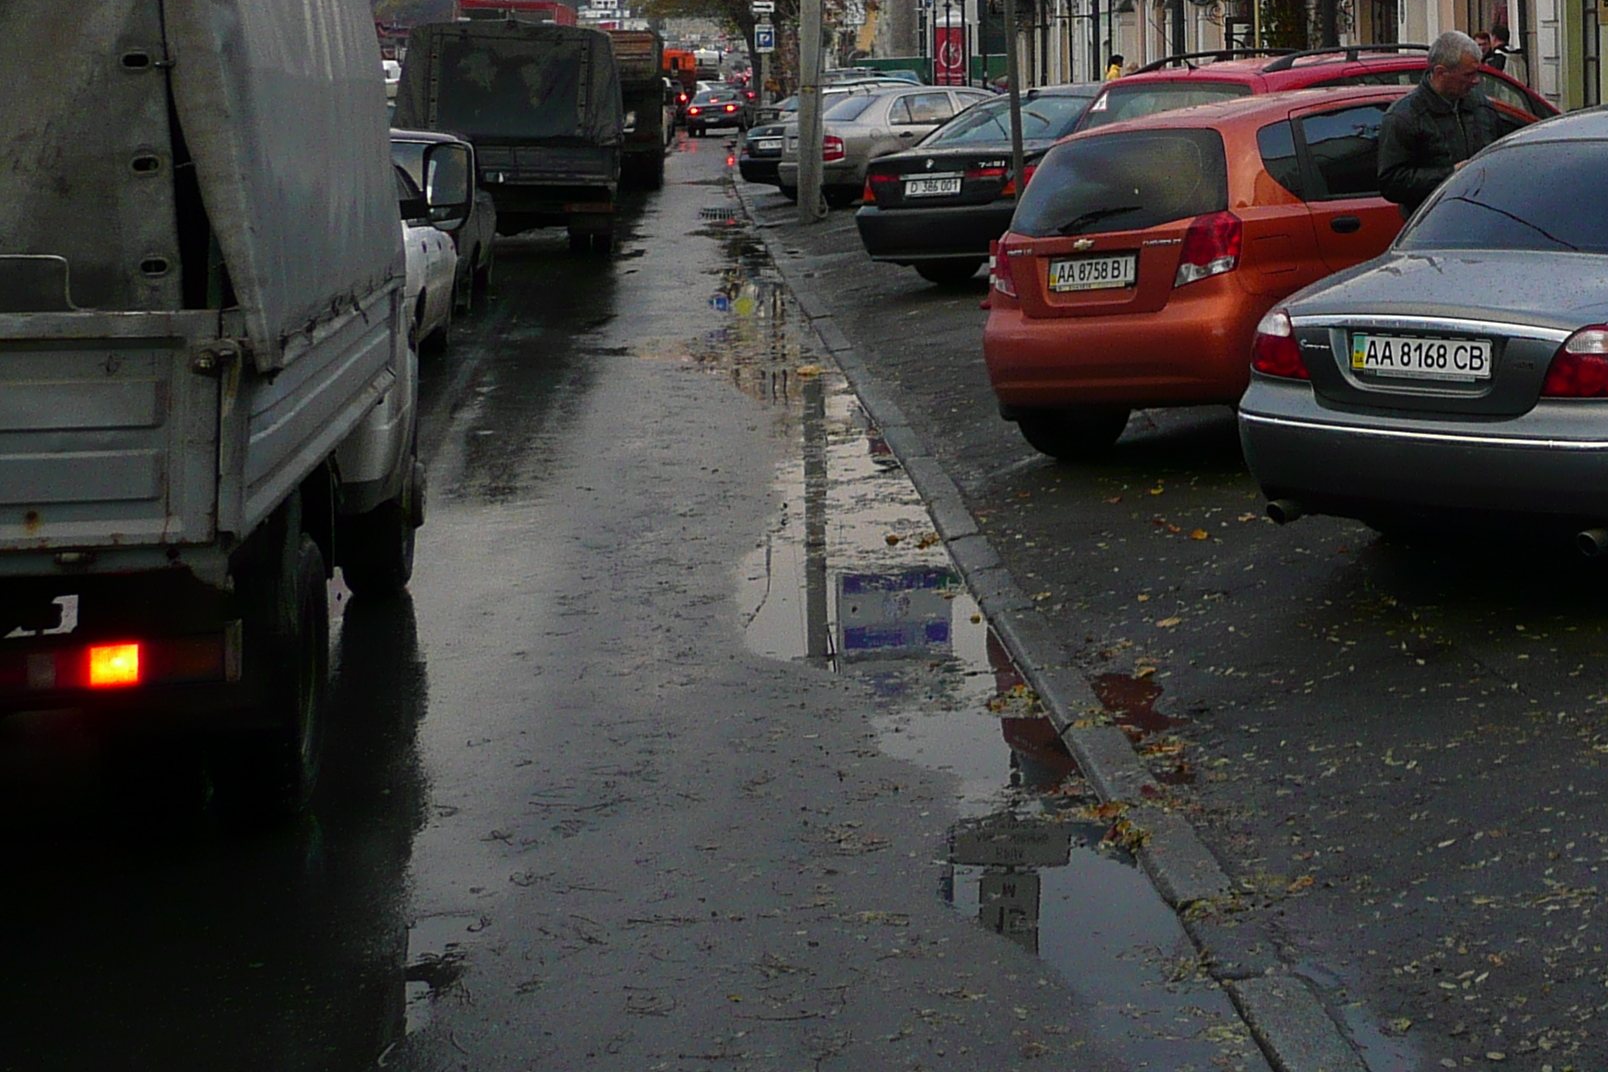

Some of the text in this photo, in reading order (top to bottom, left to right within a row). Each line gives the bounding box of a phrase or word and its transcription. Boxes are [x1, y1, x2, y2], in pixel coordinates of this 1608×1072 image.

[1057, 259, 1129, 283] AA 8758 BI
[1365, 340, 1394, 366] AA
[1400, 342, 1448, 368] 8168
[1454, 345, 1485, 371] CB
